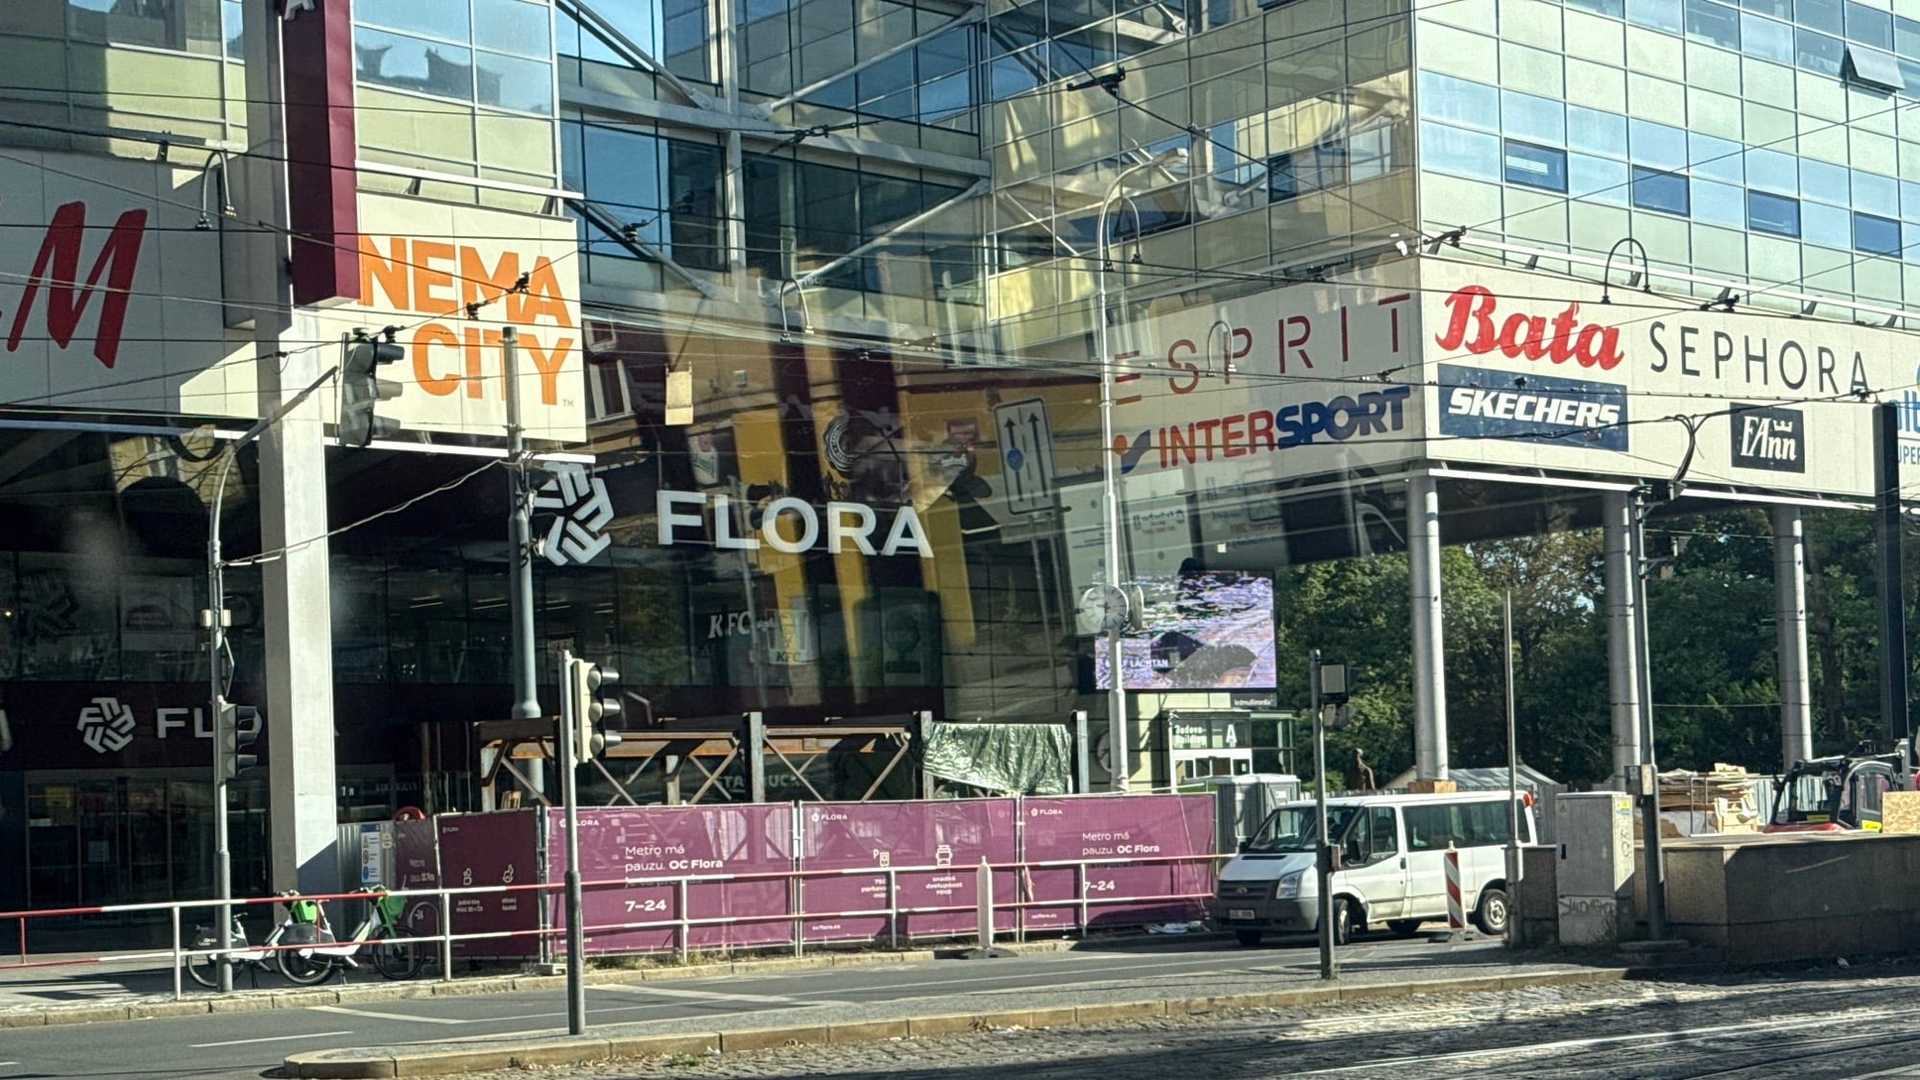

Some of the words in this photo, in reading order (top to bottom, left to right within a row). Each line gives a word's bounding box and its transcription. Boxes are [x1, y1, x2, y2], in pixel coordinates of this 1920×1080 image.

[1114, 293, 1411, 406] ESPRIT
[1648, 320, 1869, 396] SEPHORA
[1448, 387, 1621, 429] SKECHERS
[1158, 385, 1411, 469] INTERSPORT
[656, 490, 934, 558] FLORA
[708, 611, 752, 639] KFC
[625, 847, 662, 857] Metro
[665, 845, 685, 855] má
[1082, 832, 1111, 842] Metro
[1117, 845, 1132, 854] OC
[1134, 844, 1160, 853] Flora
[669, 860, 689, 869] OC
[691, 859, 723, 869] Flora
